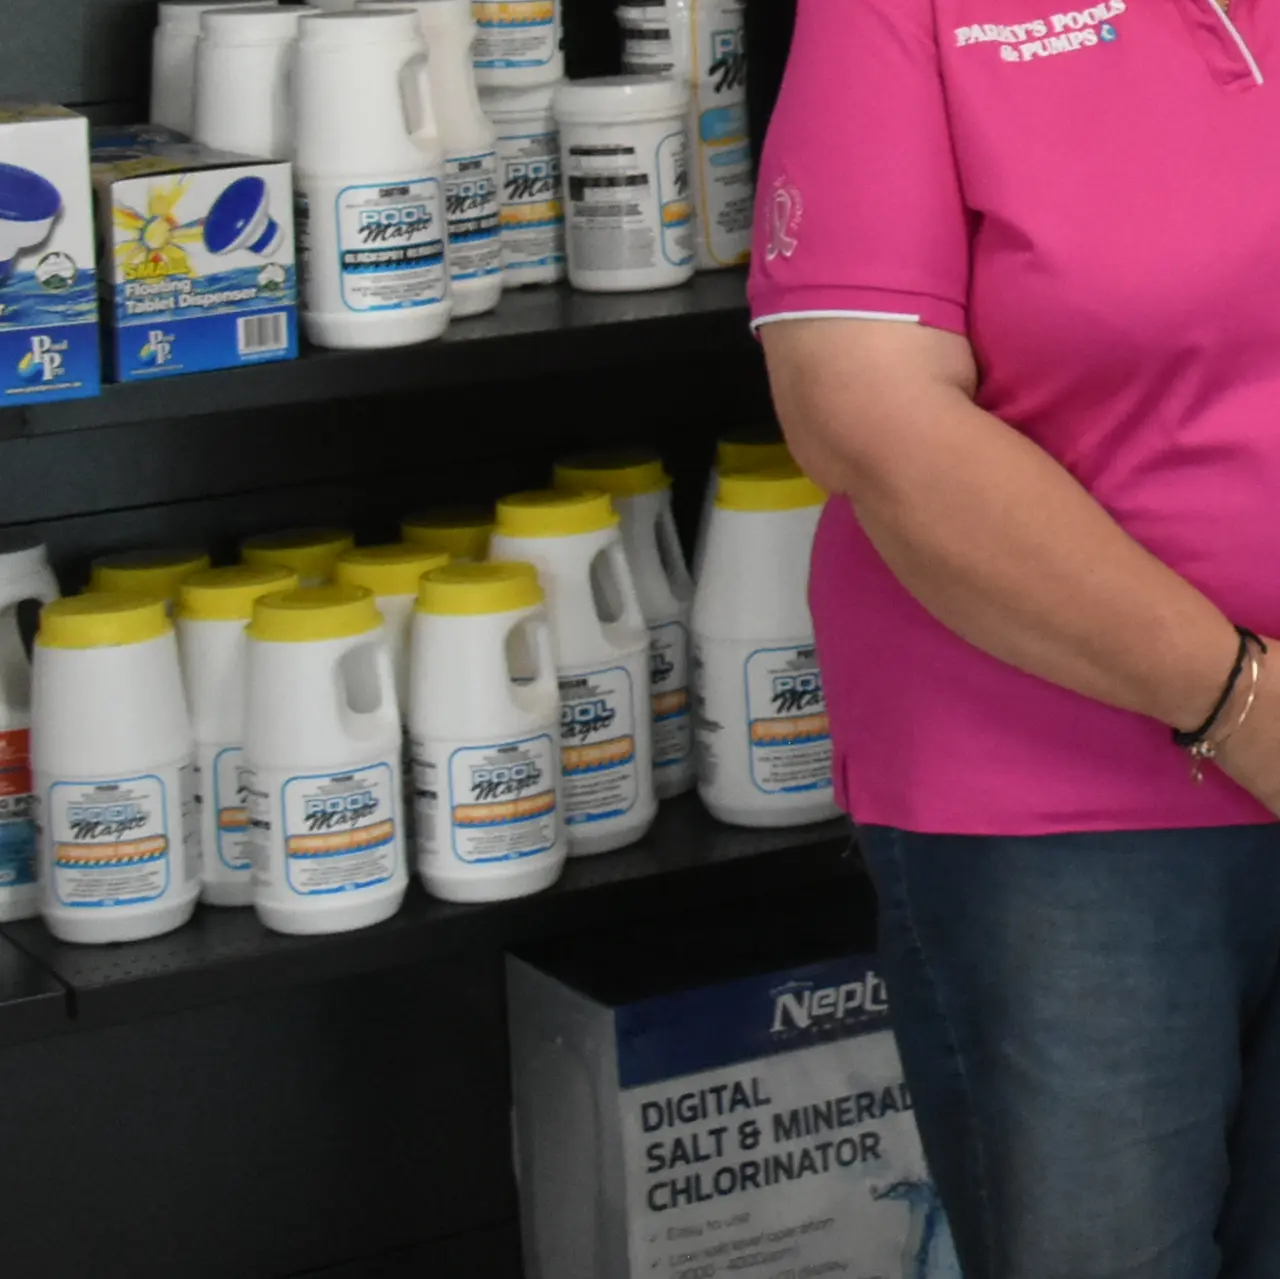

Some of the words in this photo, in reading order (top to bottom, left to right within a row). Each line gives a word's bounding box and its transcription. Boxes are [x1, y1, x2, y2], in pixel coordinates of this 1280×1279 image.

[954, 19, 1048, 47] PARKY'S
[1000, 44, 1021, 62] &
[1019, 28, 1099, 62] PUMPS
[359, 204, 432, 227] POOL
[358, 219, 432, 243] Magic
[125, 279, 192, 297] Floating
[126, 298, 175, 314] Tablet
[179, 288, 258, 307] Dispenser
[470, 761, 543, 787] POOL
[304, 790, 380, 816] POOL
[640, 1076, 771, 1134] DIGITAL
[646, 1125, 729, 1174] SALT
[738, 1120, 761, 1151] &
[772, 1081, 915, 1144] MINERAL
[647, 1130, 883, 1213] CHLORINATOR
